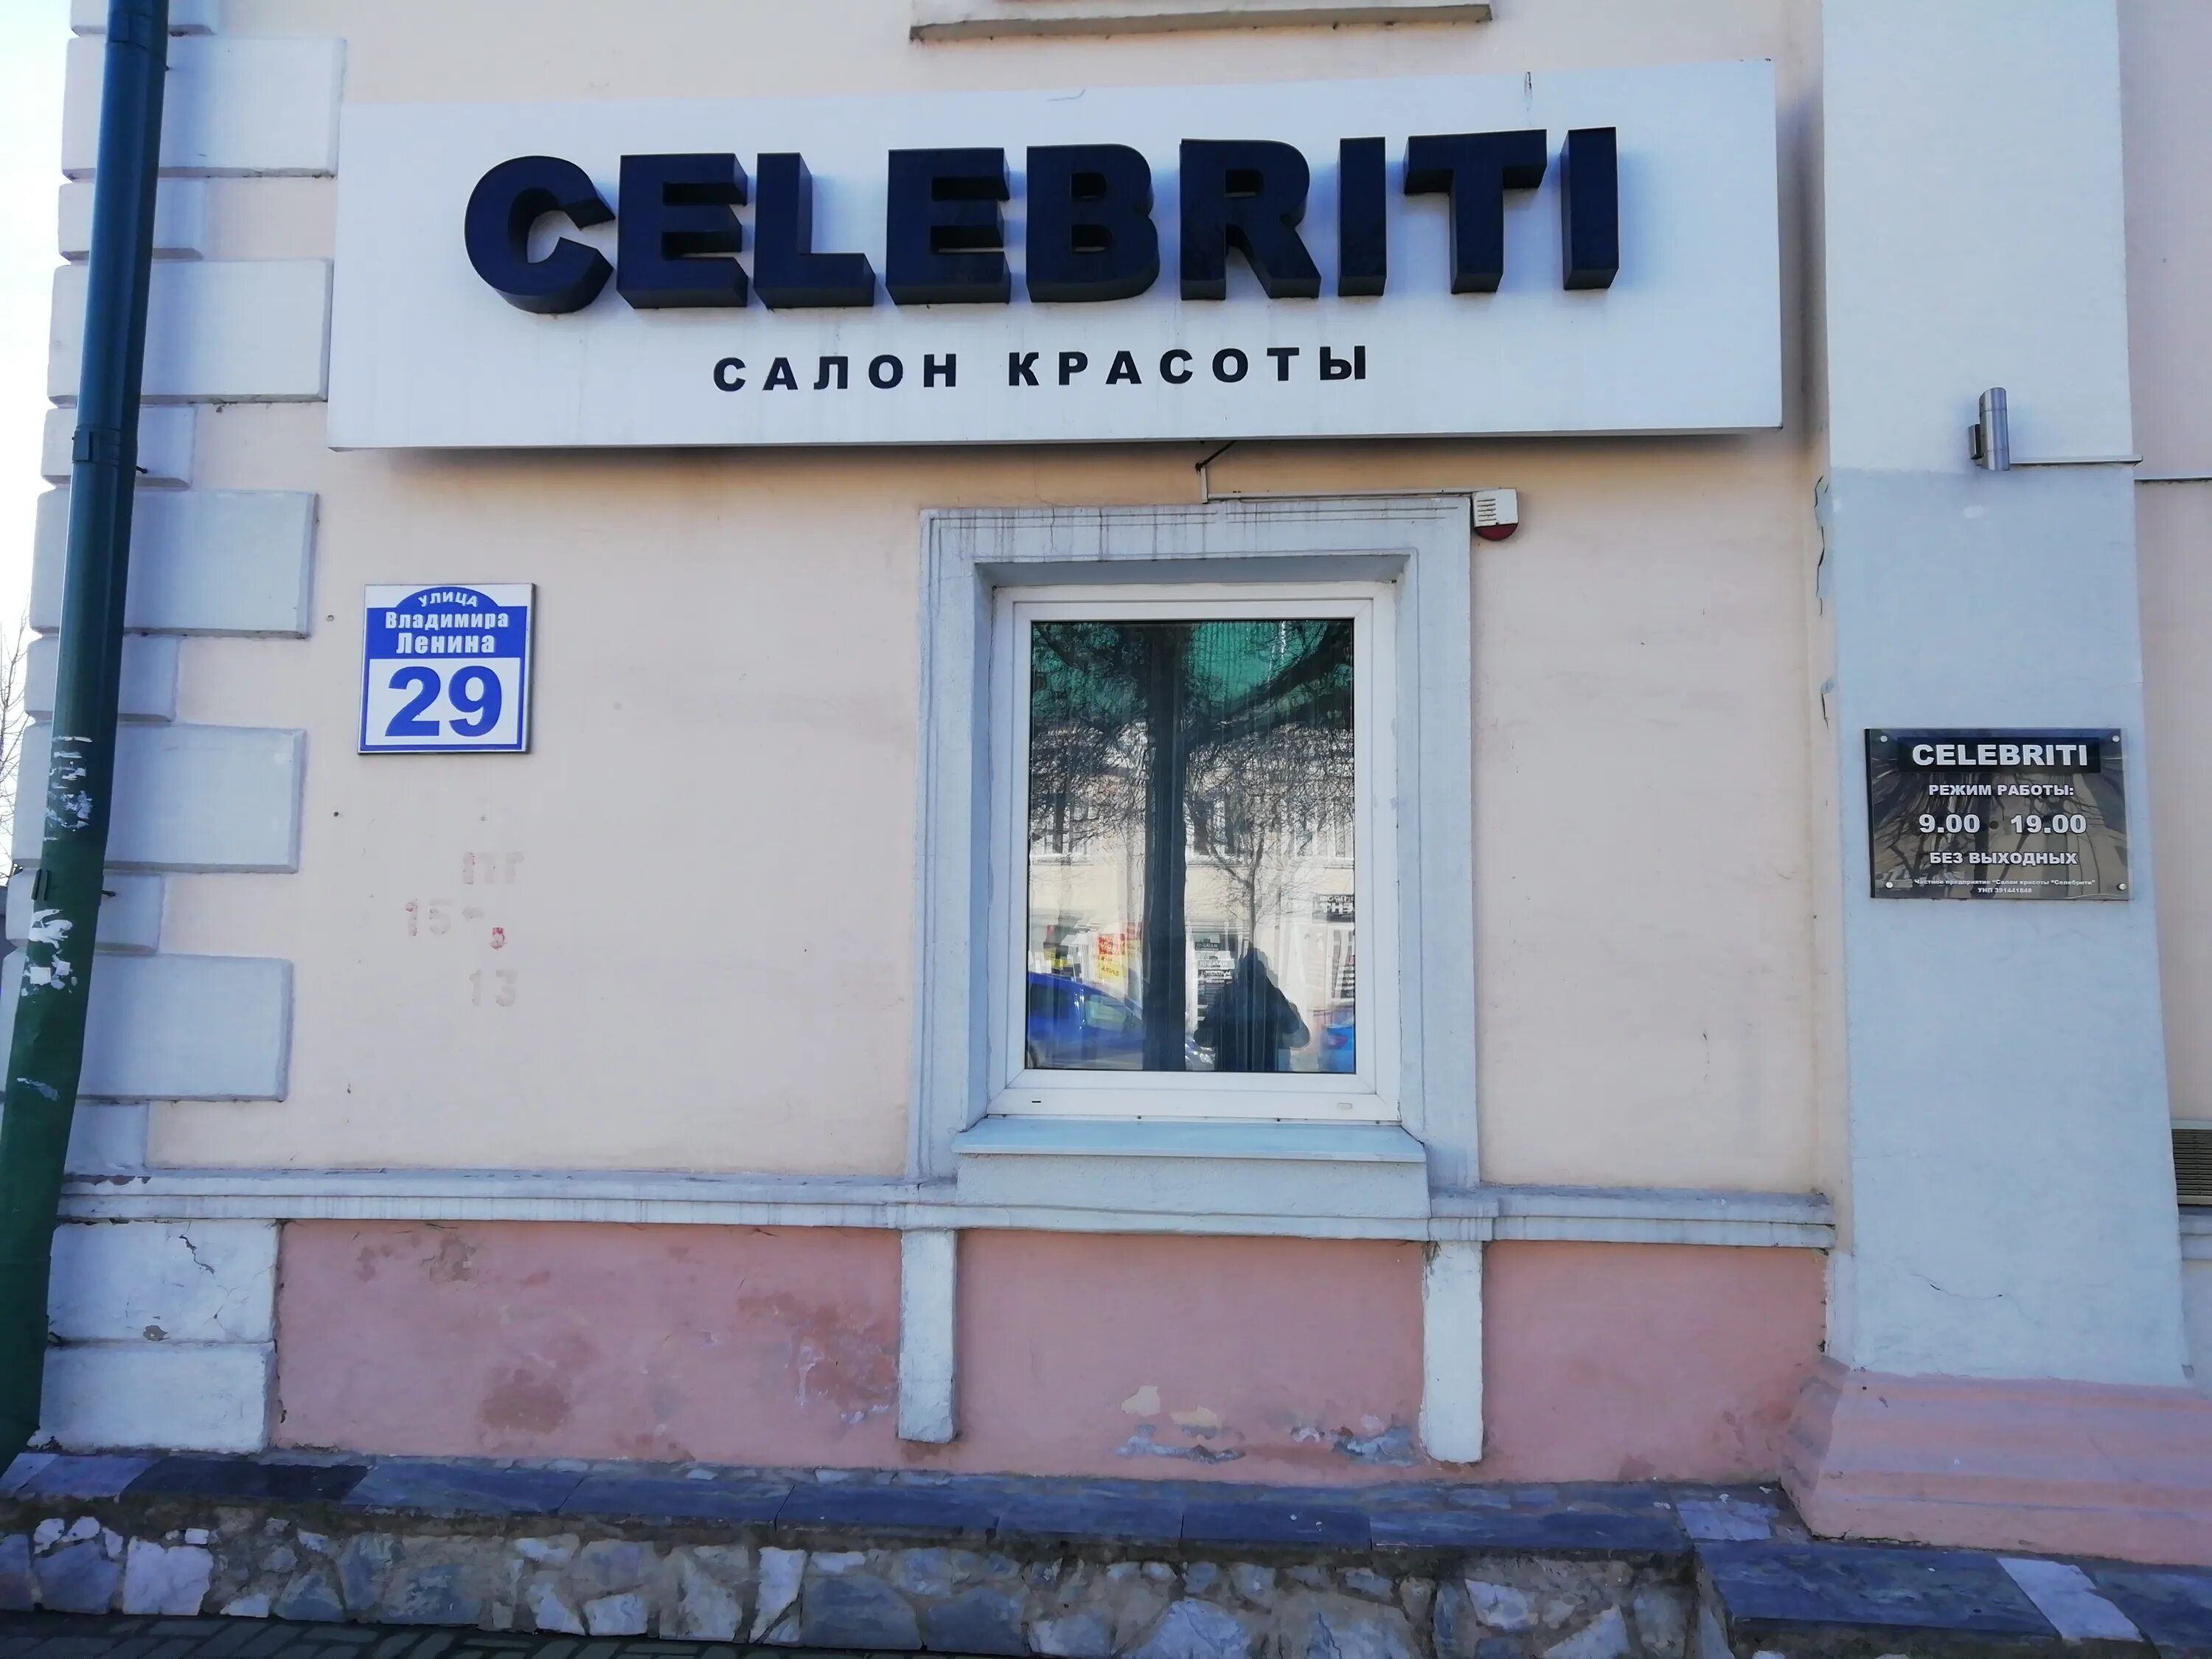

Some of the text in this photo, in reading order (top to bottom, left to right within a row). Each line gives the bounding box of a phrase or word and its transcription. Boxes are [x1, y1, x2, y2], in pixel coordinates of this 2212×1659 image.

[465, 126, 1619, 314] CELEBRITI
[713, 344, 1366, 392] САЛОН КРАСОТЫ
[418, 591, 478, 608] УЛИЦА
[385, 611, 509, 630] Владимира
[396, 633, 495, 654] Ленина
[385, 665, 502, 737] 29
[1912, 744, 2088, 766] CELEBRITI
[1929, 785, 2075, 796] РЕЖИМ РАБОТЫ:
[1919, 814, 2087, 834] 9.00 19.00
[1930, 852, 2078, 866] БЕЗ ВЫХОДНЫХ
